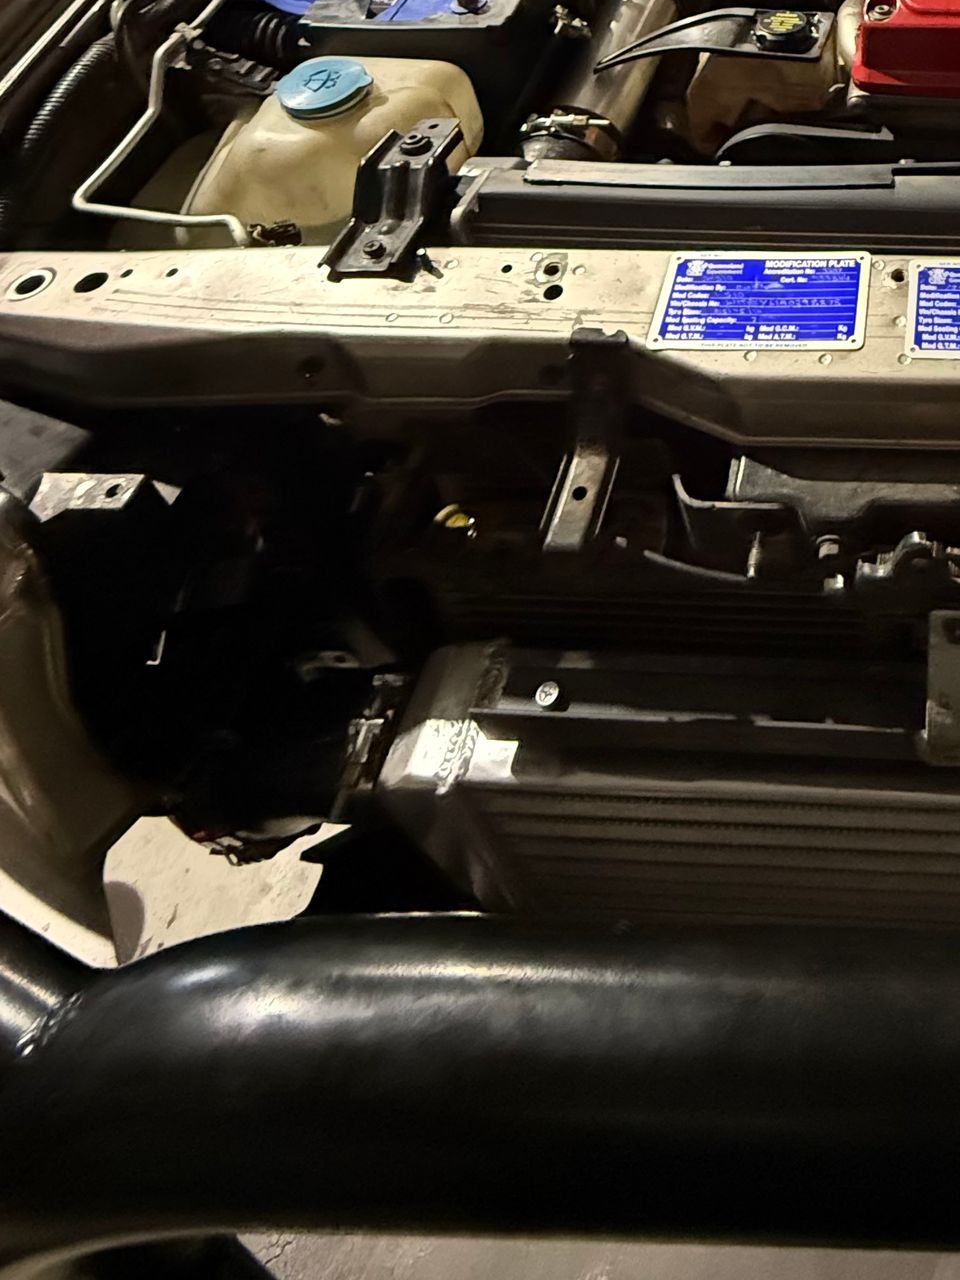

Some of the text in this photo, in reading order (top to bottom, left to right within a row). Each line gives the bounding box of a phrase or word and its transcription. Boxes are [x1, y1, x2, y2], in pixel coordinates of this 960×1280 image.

[765, 259, 856, 269] MODIFICATION PLATE
[681, 316, 705, 325] Seating
[706, 316, 737, 325] Capacity:
[667, 324, 682, 332] Mod
[759, 324, 774, 332] Mod
[917, 324, 932, 332] Mod
[933, 325, 958, 334] Seating
[665, 332, 680, 340] Mod
[758, 332, 773, 340] Mod
[922, 333, 937, 341] Mod
